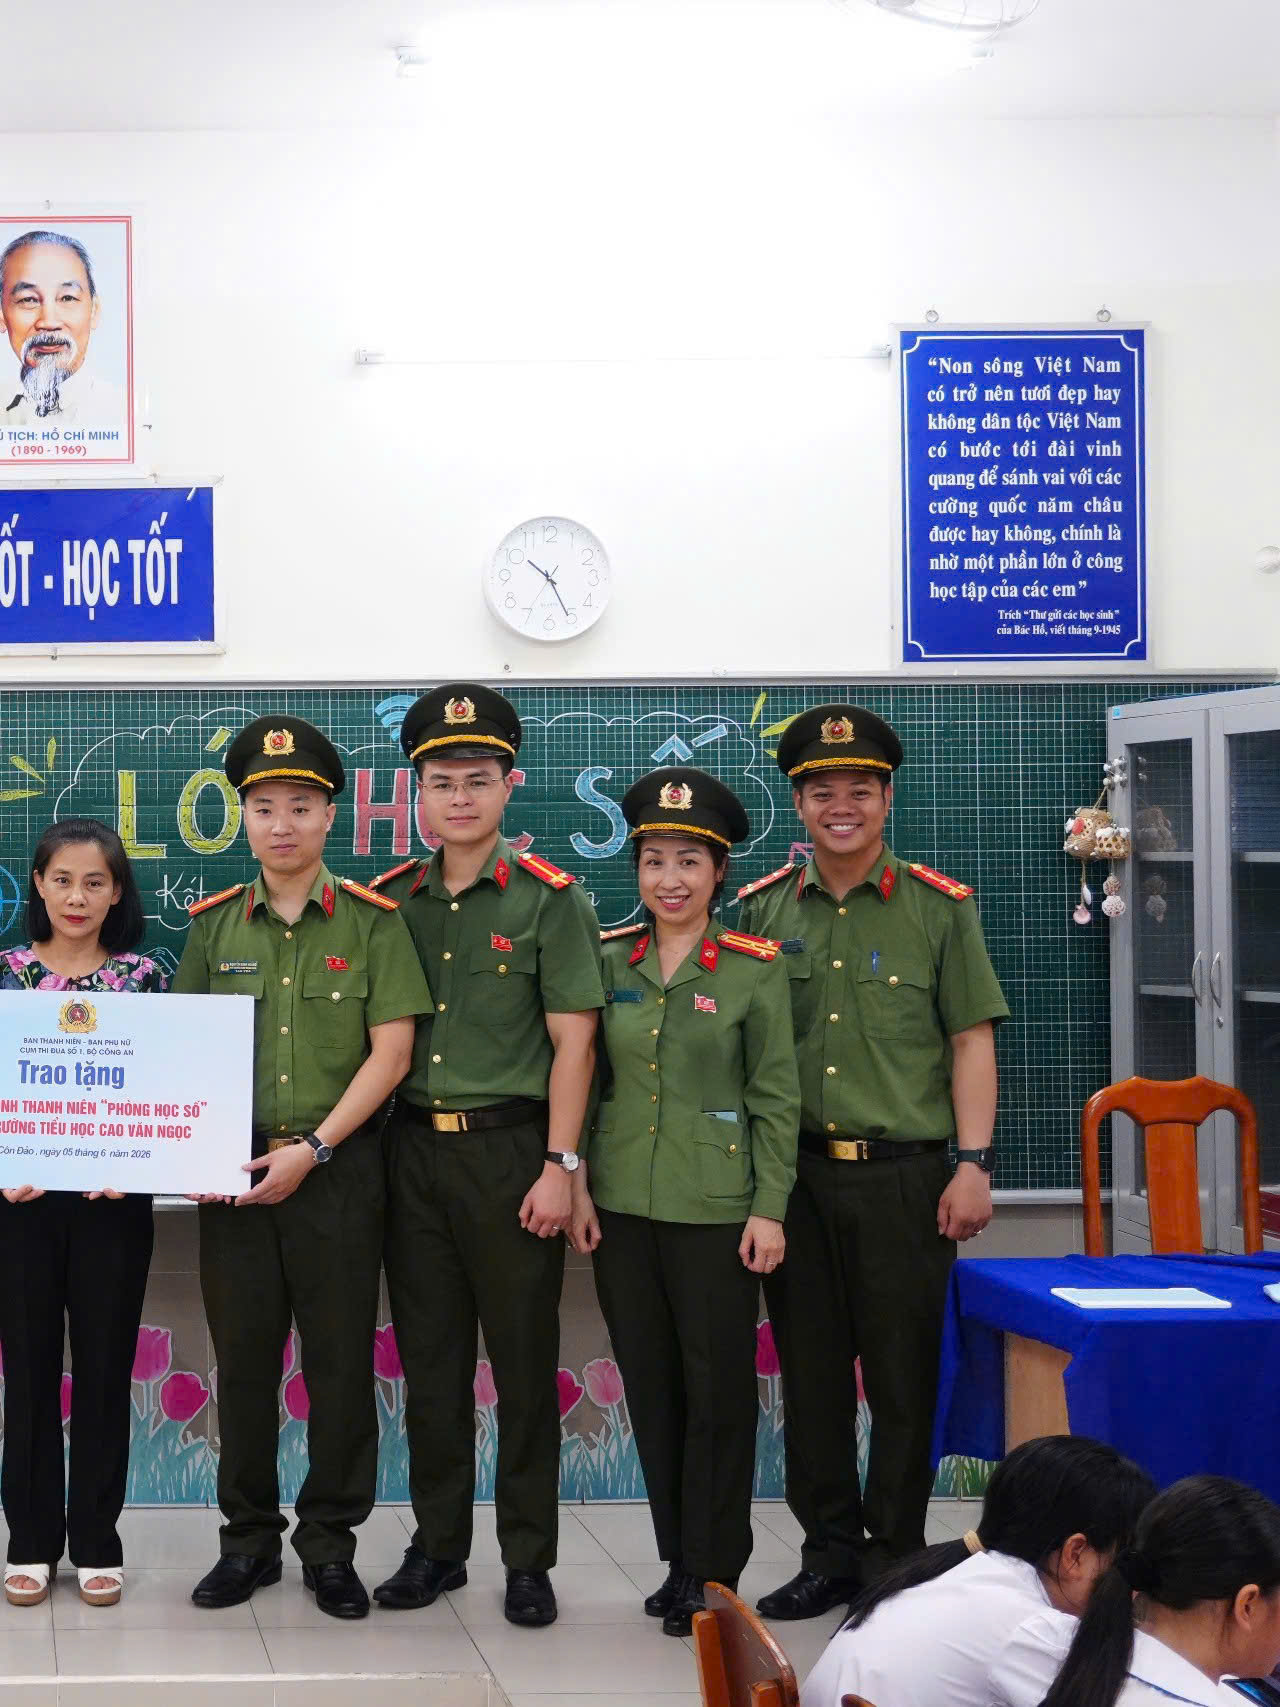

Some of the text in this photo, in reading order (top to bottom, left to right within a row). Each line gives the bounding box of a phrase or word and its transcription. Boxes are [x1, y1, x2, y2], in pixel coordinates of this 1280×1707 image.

[984, 357, 1023, 377] sông
[1034, 356, 1071, 376] Việt
[1083, 357, 1120, 372] Nam
[927, 383, 1121, 405] có trở nên tươi đẹp hay
[928, 412, 1121, 433] không dân tộc Việt Nam
[8, 431, 38, 443] TỊCH:
[64, 429, 85, 440] CHÍ
[88, 431, 119, 440] MINH
[11, 445, 87, 456] (1890 1969)
[928, 440, 1121, 458] có bước tới đài vinh
[929, 465, 1121, 490] quang để sánh vai với các
[929, 494, 1122, 518] cường quốc năm châu
[542, 525, 558, 543] 12
[929, 524, 1121, 545] được hay không, chính là
[63, 539, 120, 620] HỌC
[128, 512, 182, 605] TỐT
[930, 549, 1123, 573] nhờ một phần lớn ở công
[930, 582, 957, 601] học
[962, 582, 987, 602] tập
[991, 579, 1018, 597] của
[1023, 580, 1048, 597] các
[998, 609, 1094, 621] Trích gửi các học
[997, 623, 1120, 636] của Bác Hồ, viết tháng 9-1945
[118, 726, 242, 858] LỚ
[68, 1046, 77, 1054] SỐ
[87, 1048, 97, 1056] BỘ
[18, 1060, 124, 1091] Trao tặng
[22, 1100, 62, 1114] THANH
[67, 1099, 96, 1114] NIÊN
[155, 1104, 179, 1120] HỌC
[40, 1117, 66, 1135] TIỂU
[71, 1123, 94, 1138] HỌC
[100, 1123, 124, 1136] CAO
[128, 1122, 152, 1137] VĂN
[157, 1125, 191, 1141] NGỌC
[40, 1148, 61, 1157] ngày
[75, 1148, 99, 1158] tháng
[101, 1149, 106, 1157] 6
[131, 1150, 151, 1158] 2026
